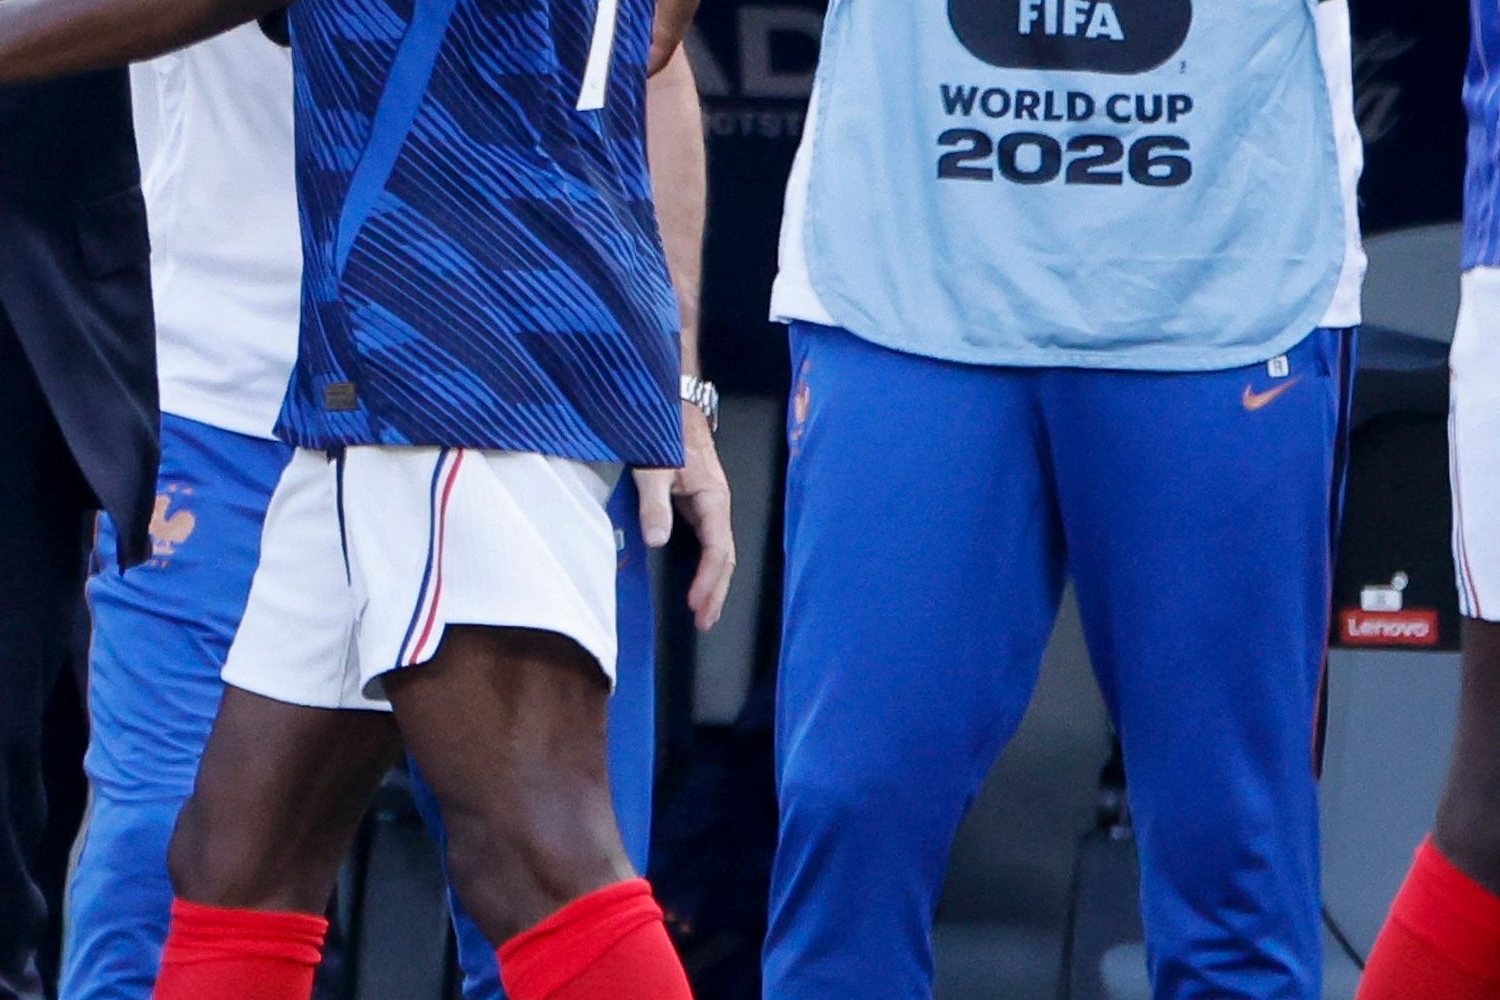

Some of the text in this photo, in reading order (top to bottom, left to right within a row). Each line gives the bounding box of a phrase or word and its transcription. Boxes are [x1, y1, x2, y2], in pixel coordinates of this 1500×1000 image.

[939, 83, 1194, 124] WORLD CUP
[936, 127, 1193, 188] 2026
[1347, 618, 1430, 638] Lenovo
